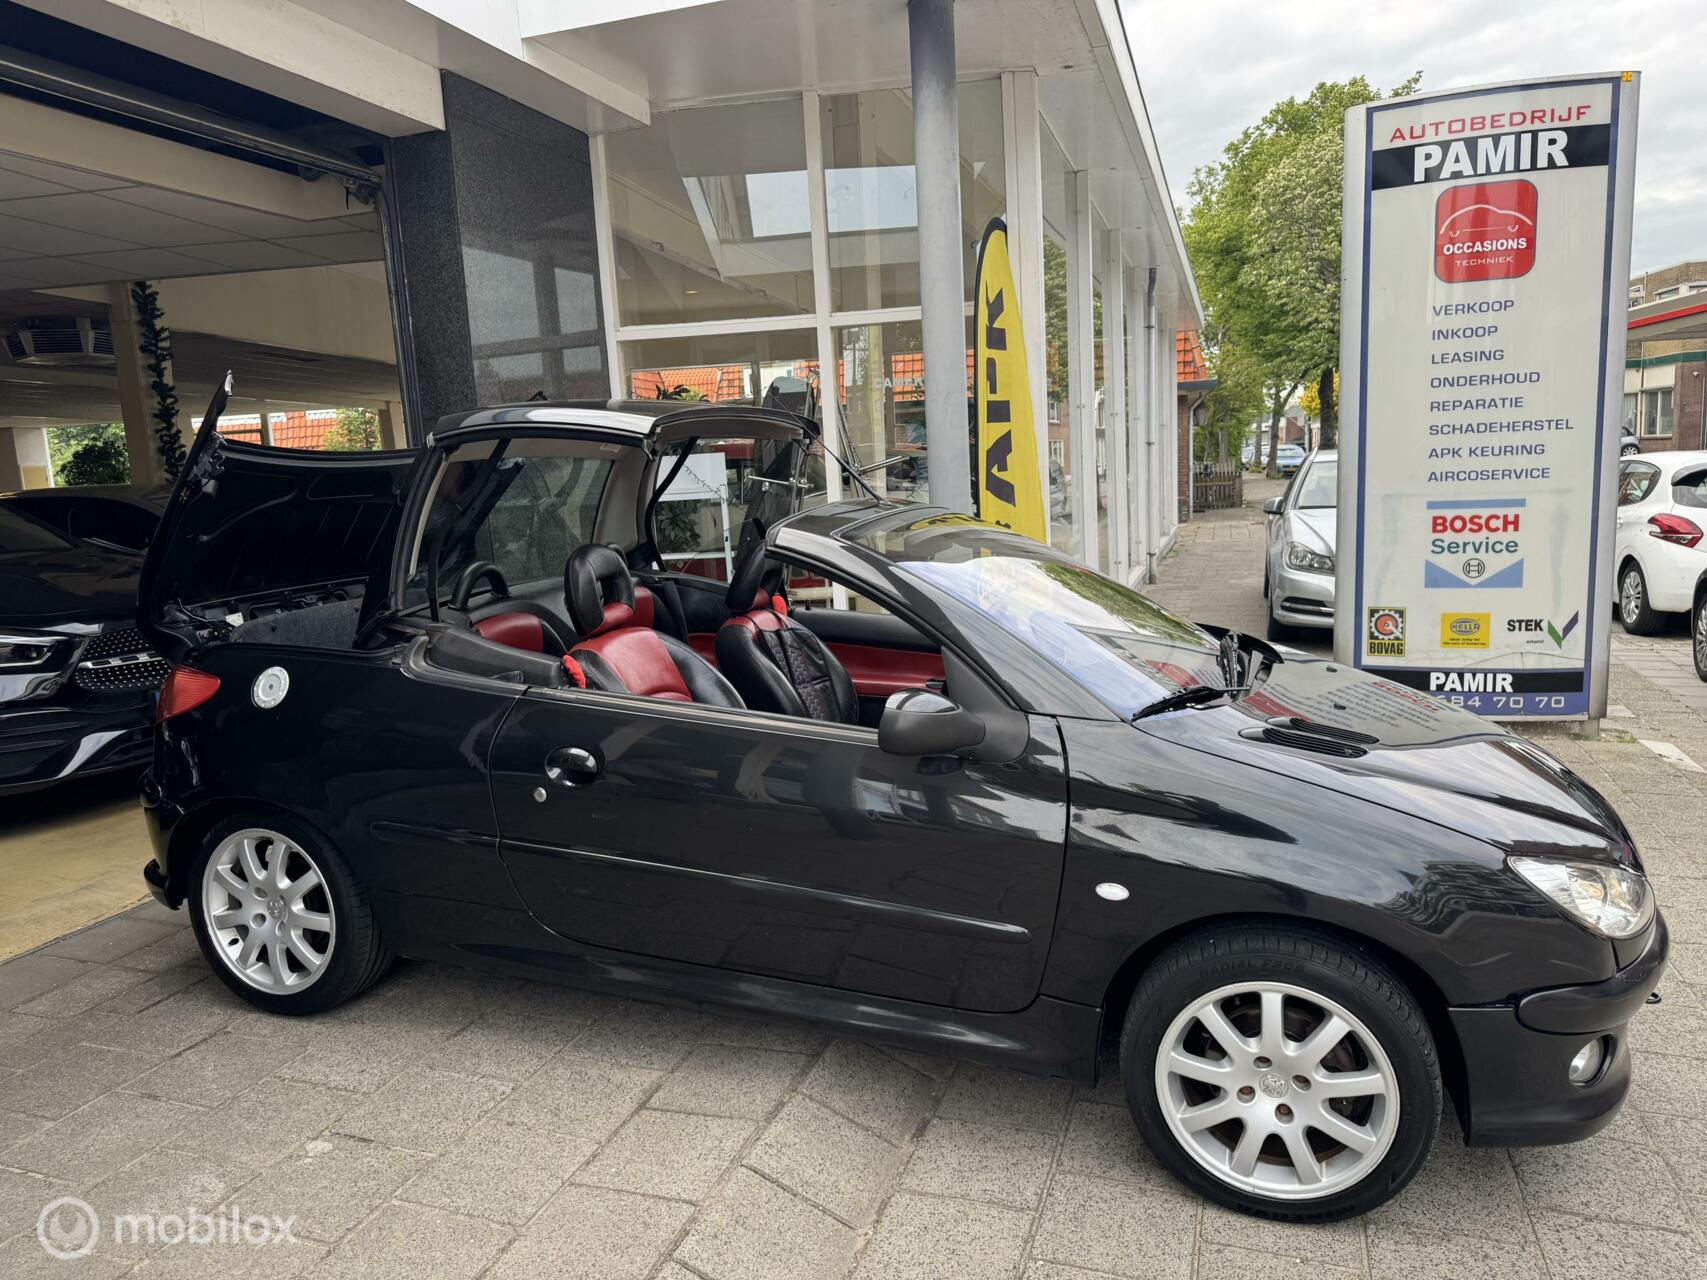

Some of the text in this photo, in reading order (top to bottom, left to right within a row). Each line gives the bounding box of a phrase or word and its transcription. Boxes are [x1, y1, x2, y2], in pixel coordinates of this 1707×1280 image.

[1389, 105, 1592, 143] AUTOBEDRIJF
[1413, 130, 1569, 183] PAMIR
[1443, 237, 1527, 255] OCCASIONS
[1455, 256, 1513, 267] TECHNIEK
[1432, 300, 1515, 317] VERKOOP
[1432, 325, 1498, 341] INKOOP
[1431, 349, 1505, 365] LEASING
[1430, 371, 1541, 388] ONDERHOUD
[985, 280, 1016, 507] APK
[1430, 396, 1524, 412] REPARATIE
[1429, 418, 1574, 436] SCHADEHERSTEL
[1428, 444, 1546, 459] APK KEURING
[1427, 467, 1551, 482] AIRCOSERVICE
[1431, 513, 1520, 534] BOSCH
[1430, 537, 1519, 554] Service
[1452, 622, 1480, 632] HELLA
[1506, 618, 1544, 632] STEK
[1369, 641, 1404, 655] BOVAG
[1429, 671, 1514, 693] PAMIR
[1493, 695, 1524, 709] 70
[1535, 695, 1565, 709] 70
